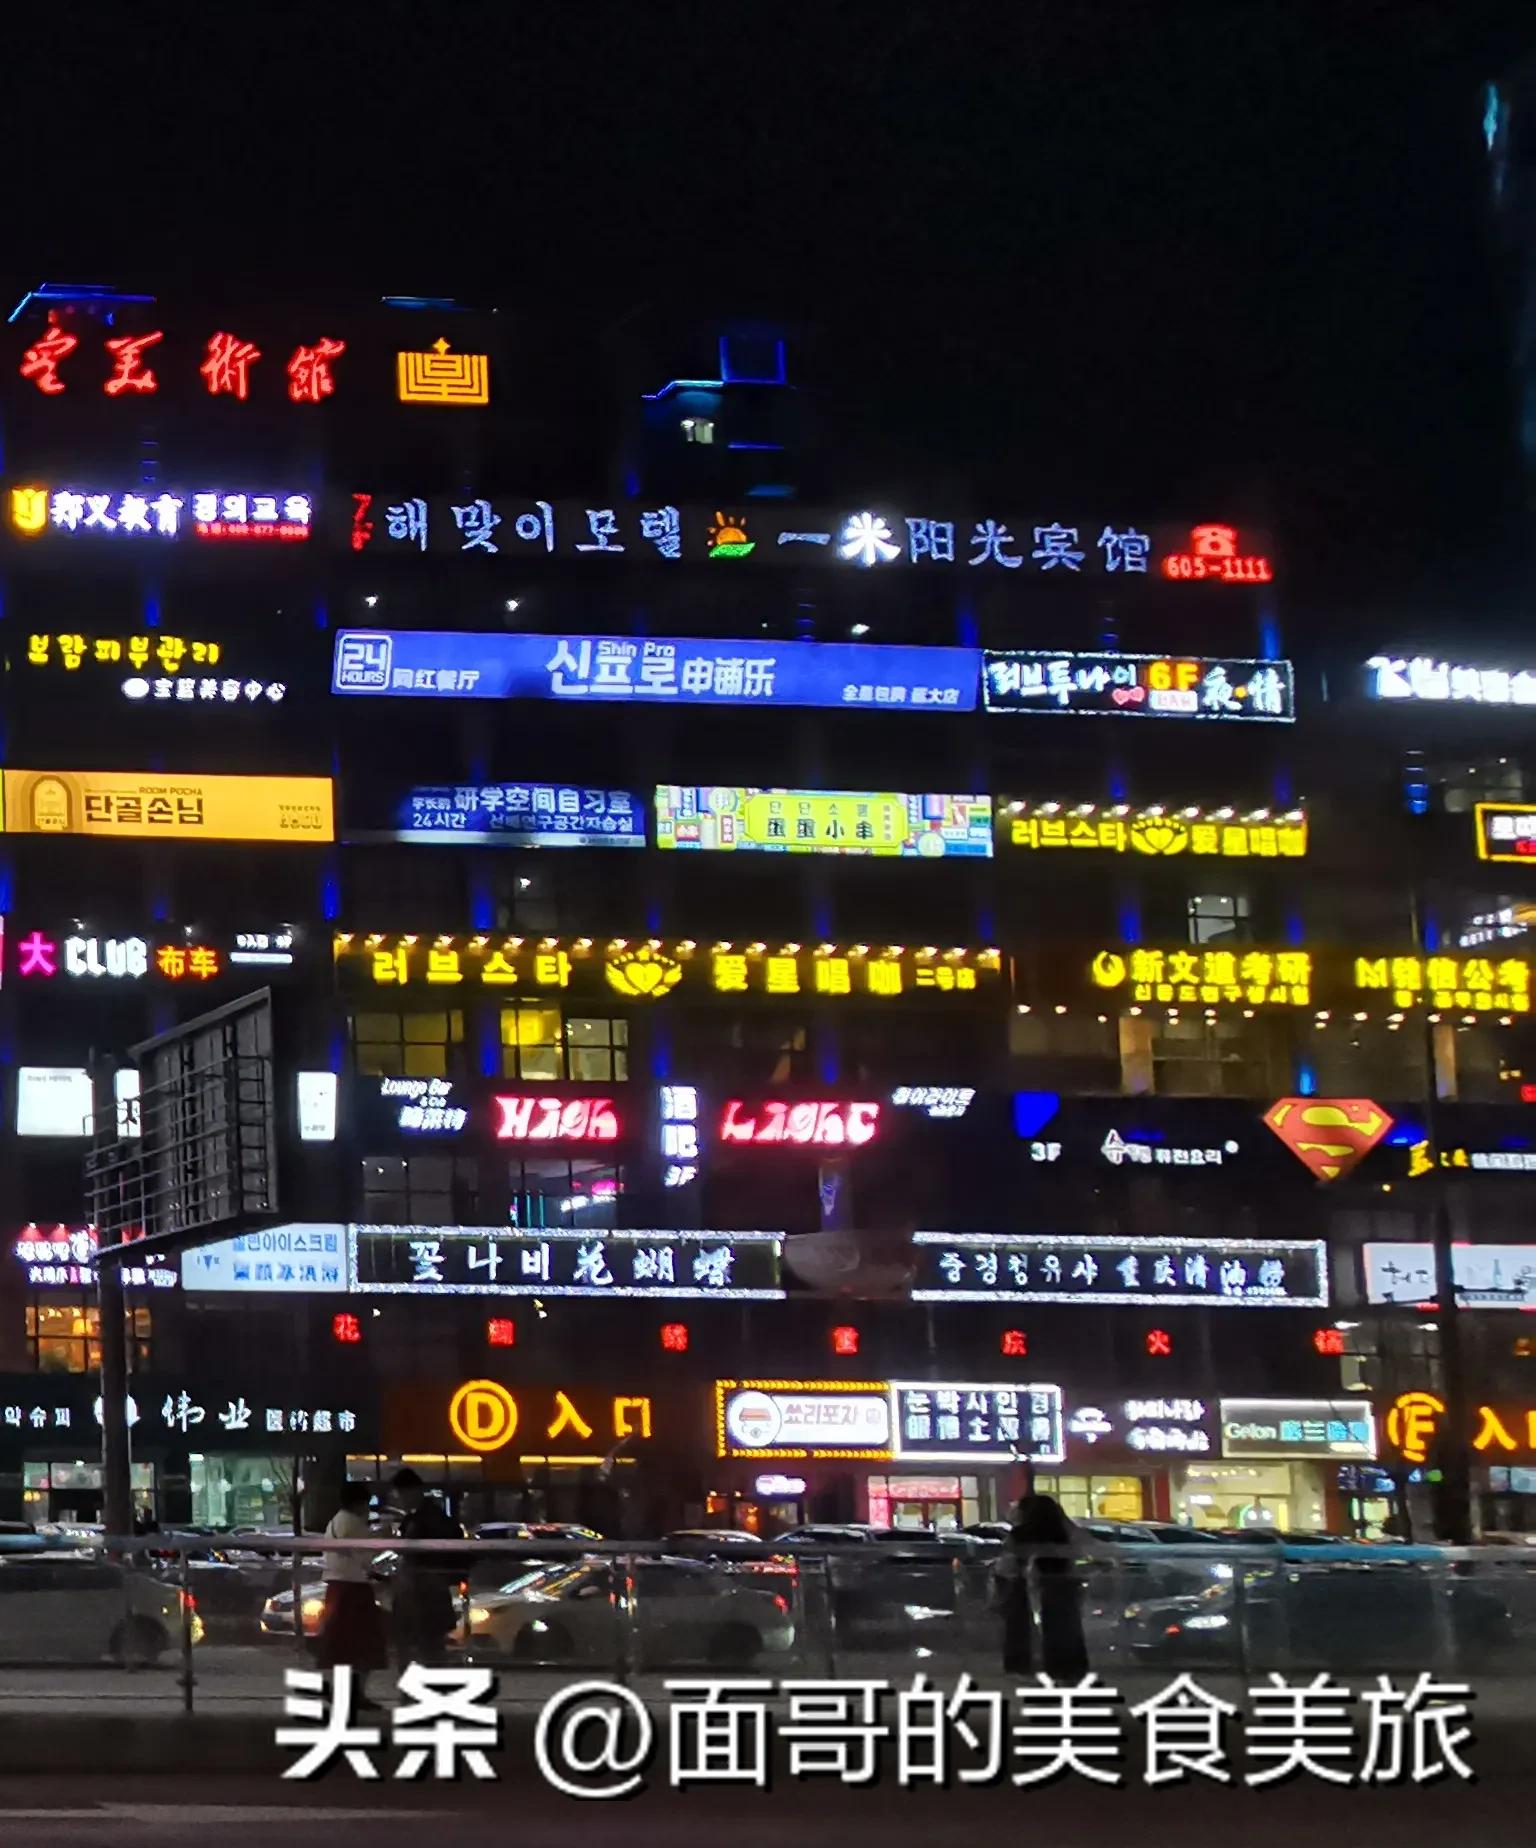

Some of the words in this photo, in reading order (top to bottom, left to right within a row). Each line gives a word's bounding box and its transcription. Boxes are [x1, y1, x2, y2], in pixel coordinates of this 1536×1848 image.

[384, 498, 683, 559] 해맞이모텔
[776, 510, 1152, 574] 一米阳光宾馆
[1165, 555, 1273, 582] 605-1111
[342, 642, 388, 671] 24
[598, 640, 637, 657] Shin
[341, 670, 386, 685] HOURS
[1148, 661, 1201, 690] 6F
[84, 795, 205, 826] 단골손님
[453, 786, 634, 815] 研学空间自习室
[412, 813, 468, 830] 24시간
[1011, 818, 1129, 852] 러브스타
[18, 931, 57, 976] 大
[63, 935, 148, 979] CLUB
[372, 949, 573, 986] 러브스타
[1030, 1142, 1062, 1162] 3F
[547, 1390, 652, 1440] 入口
[1473, 1406, 1536, 1451] 入
